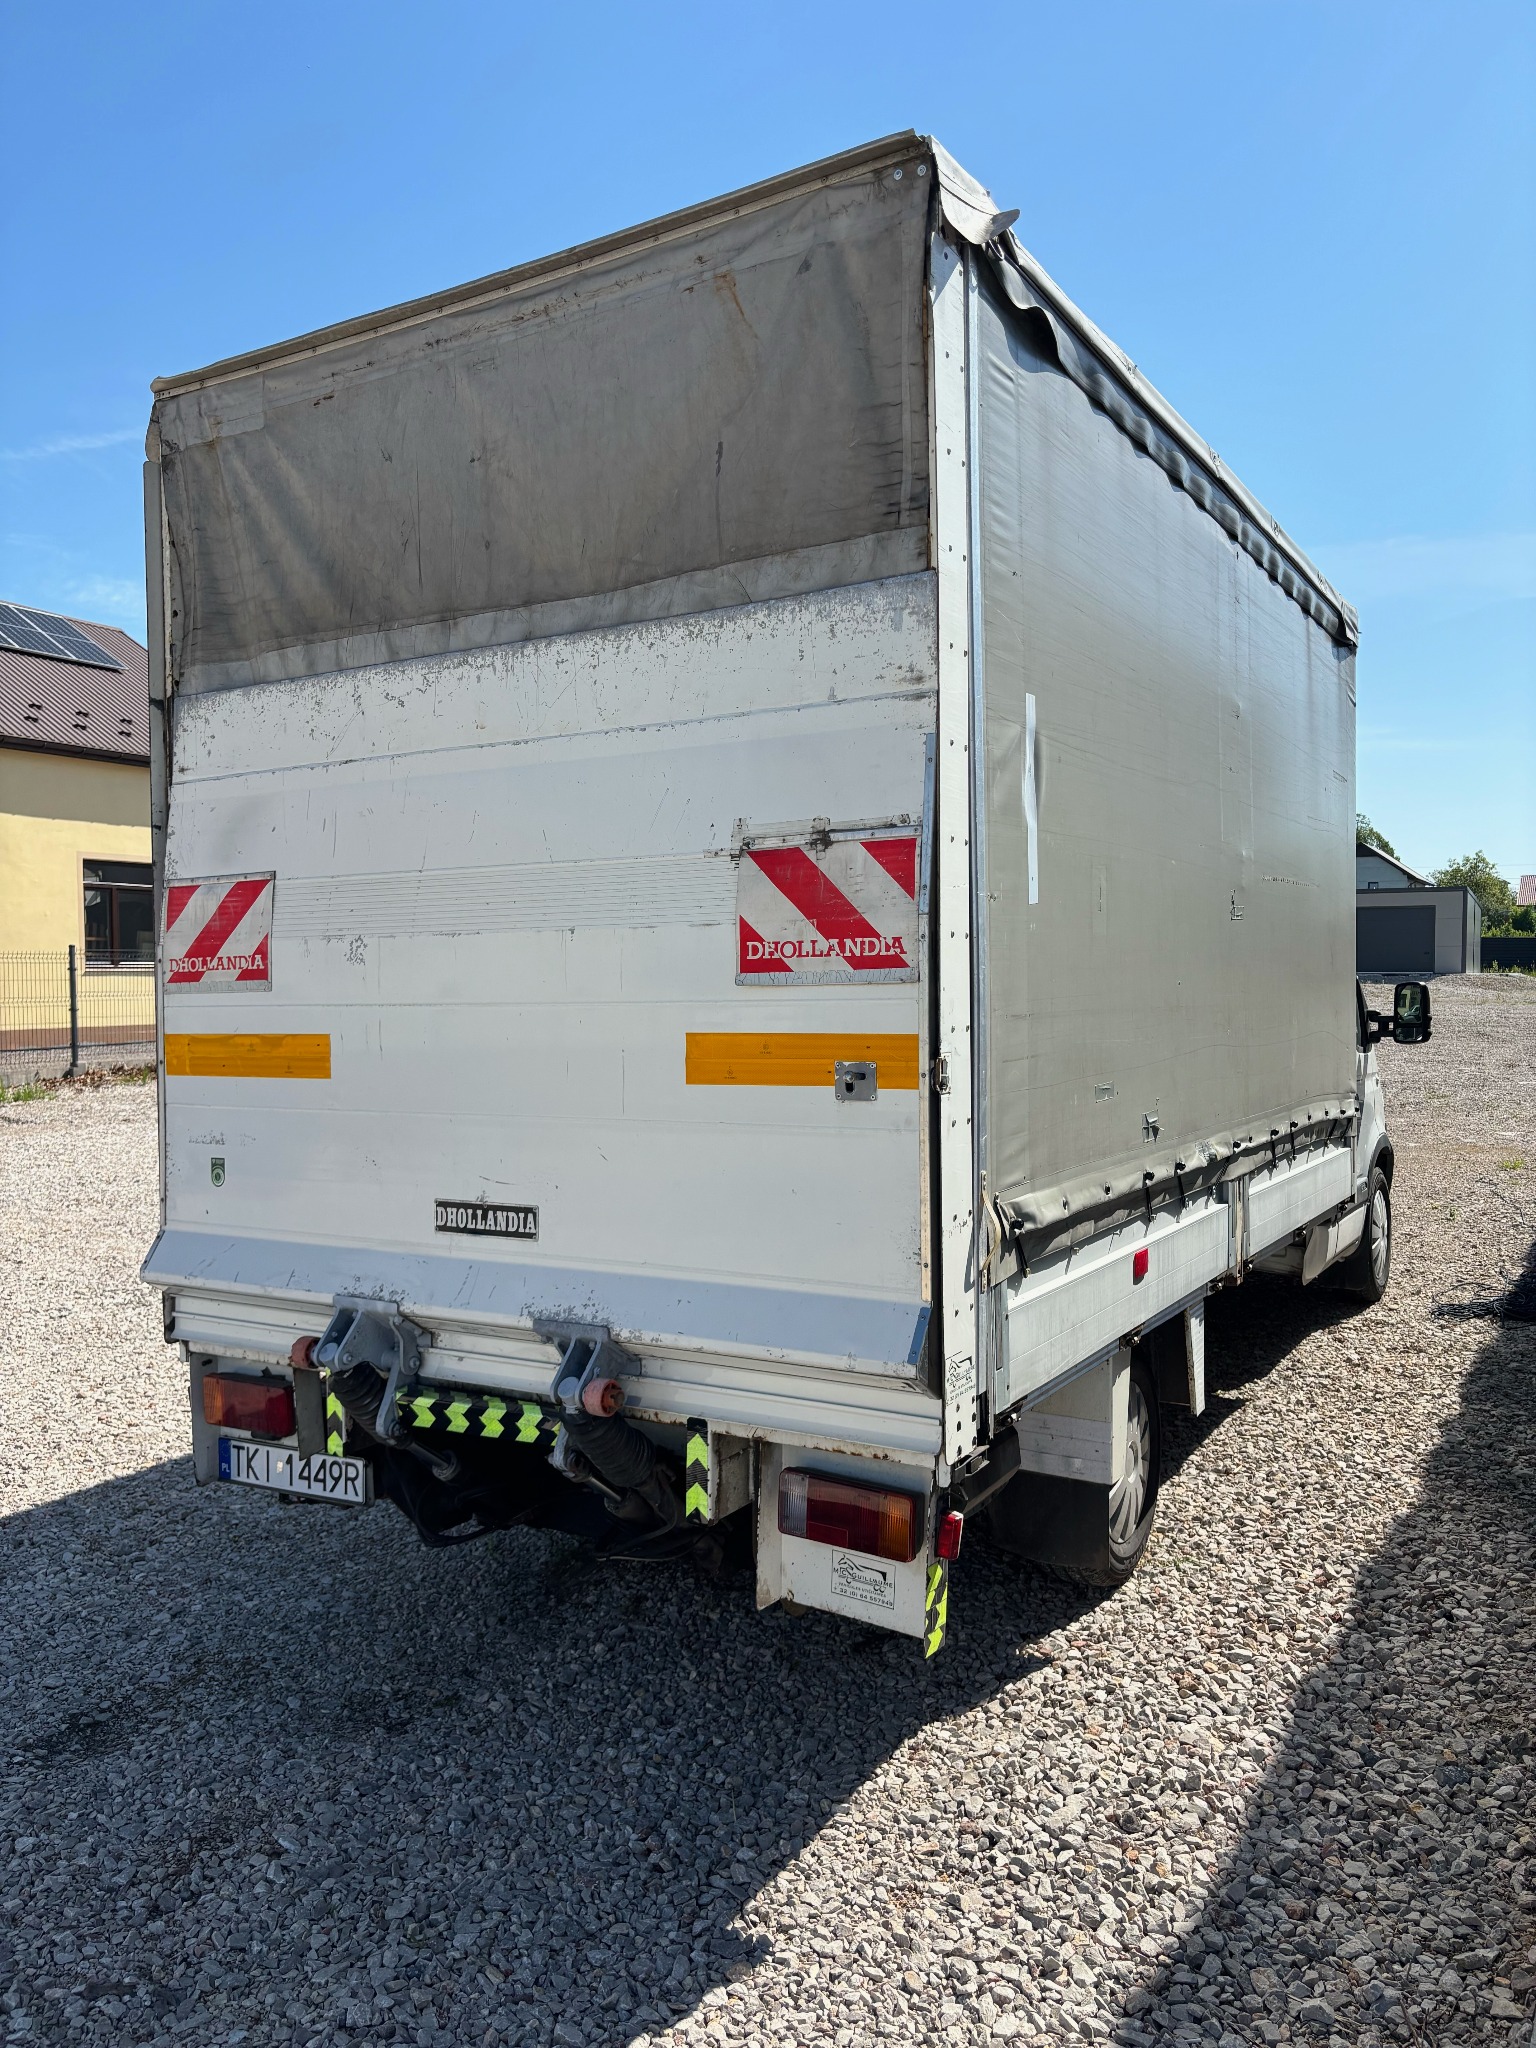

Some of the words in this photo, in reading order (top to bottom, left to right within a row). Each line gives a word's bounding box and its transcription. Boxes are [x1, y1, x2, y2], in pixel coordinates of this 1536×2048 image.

[745, 935, 909, 960] DHOLLANDIA
[168, 954, 265, 973] DHOLLANDIA
[436, 1206, 537, 1234] DHOLLANDIA
[221, 1462, 231, 1473] PL
[232, 1444, 270, 1483] TKI
[285, 1453, 359, 1497] 1449R
